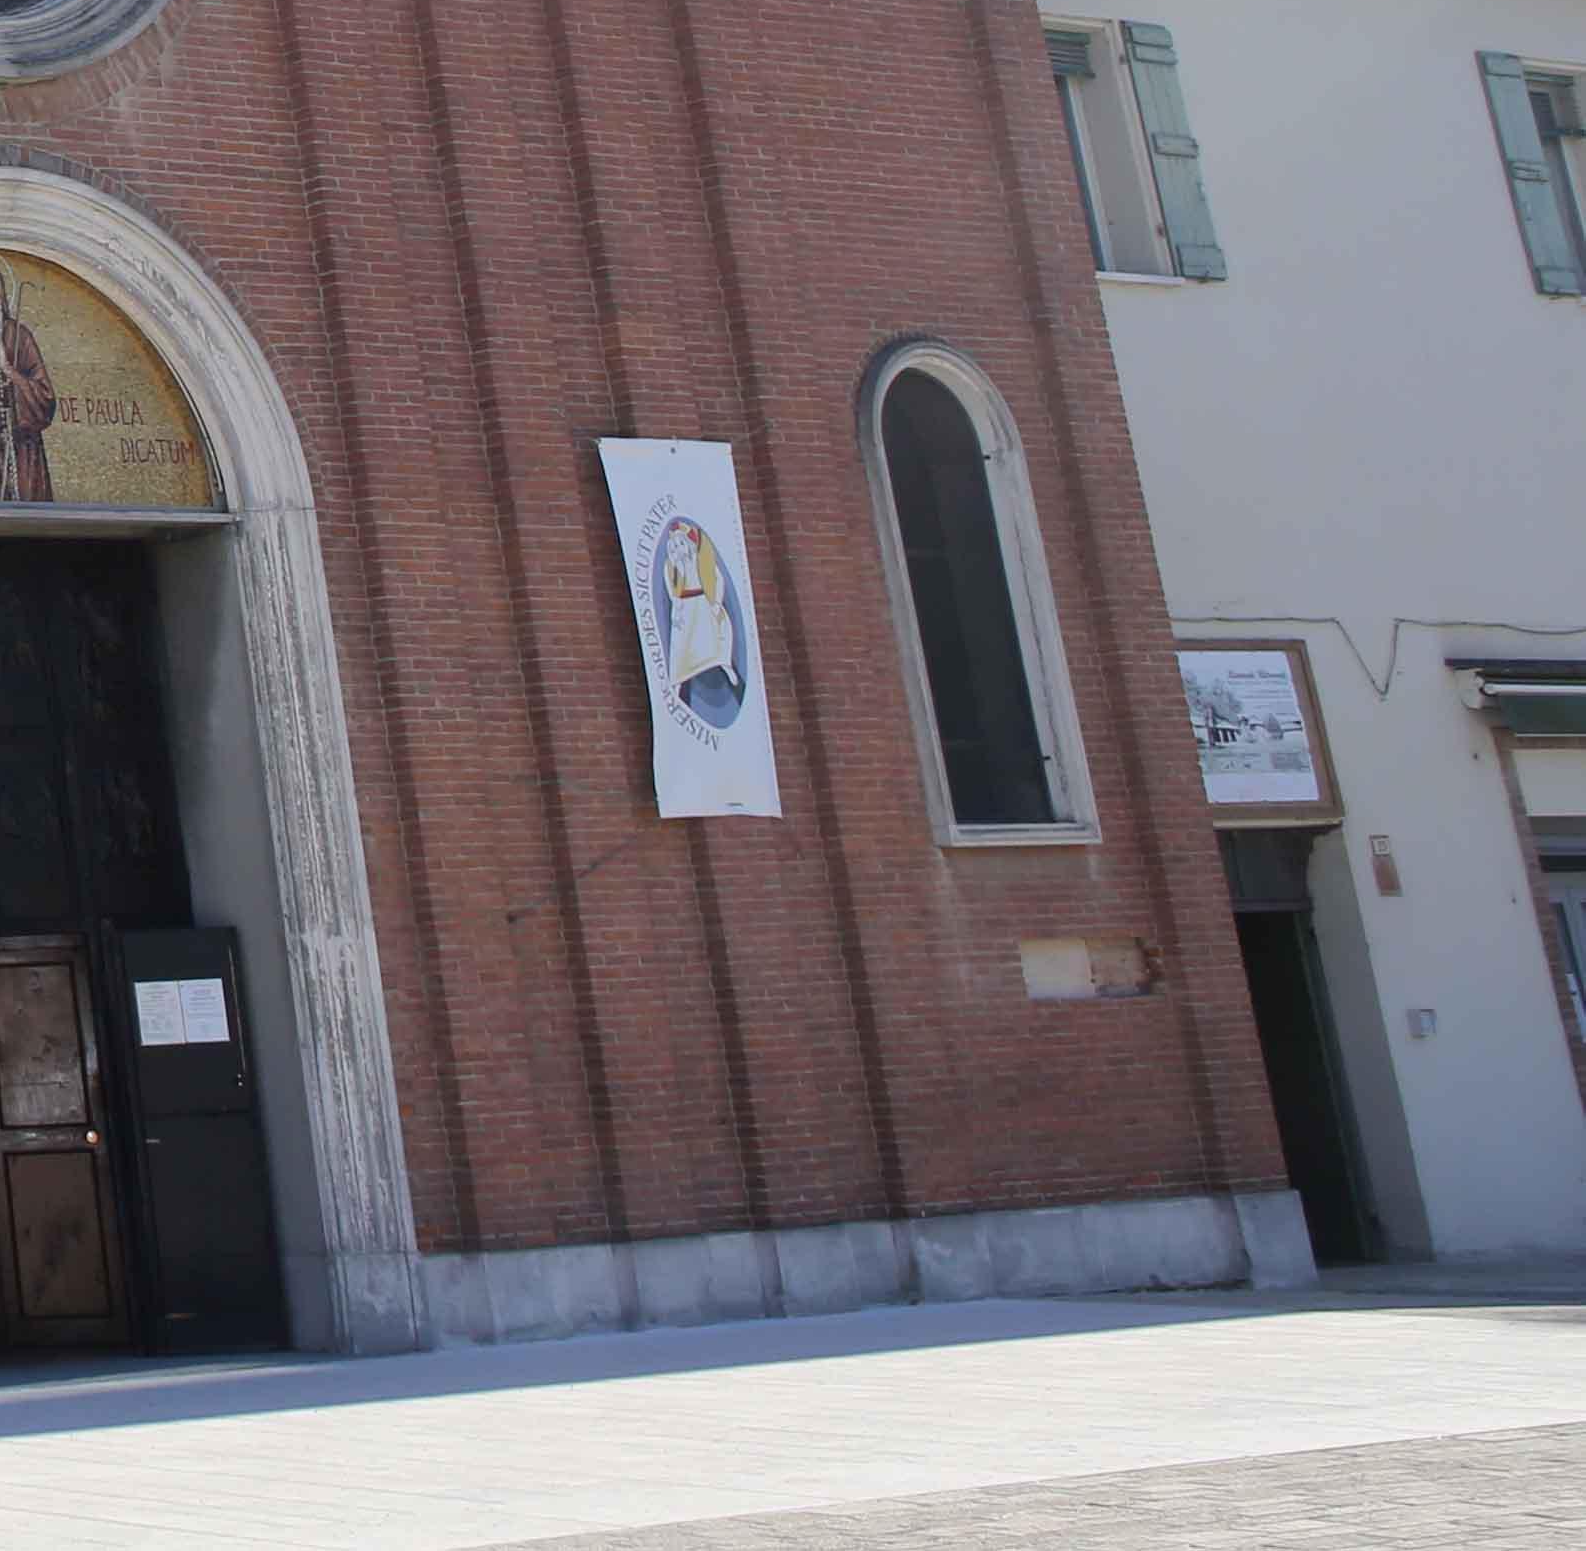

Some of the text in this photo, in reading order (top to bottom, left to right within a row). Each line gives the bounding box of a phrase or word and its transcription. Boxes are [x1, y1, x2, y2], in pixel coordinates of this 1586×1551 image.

[59, 397, 80, 423] DE
[85, 397, 145, 426] PAULA
[120, 437, 197, 465] DICATUM
[640, 493, 678, 540] PATER
[635, 537, 652, 602] SICUT
